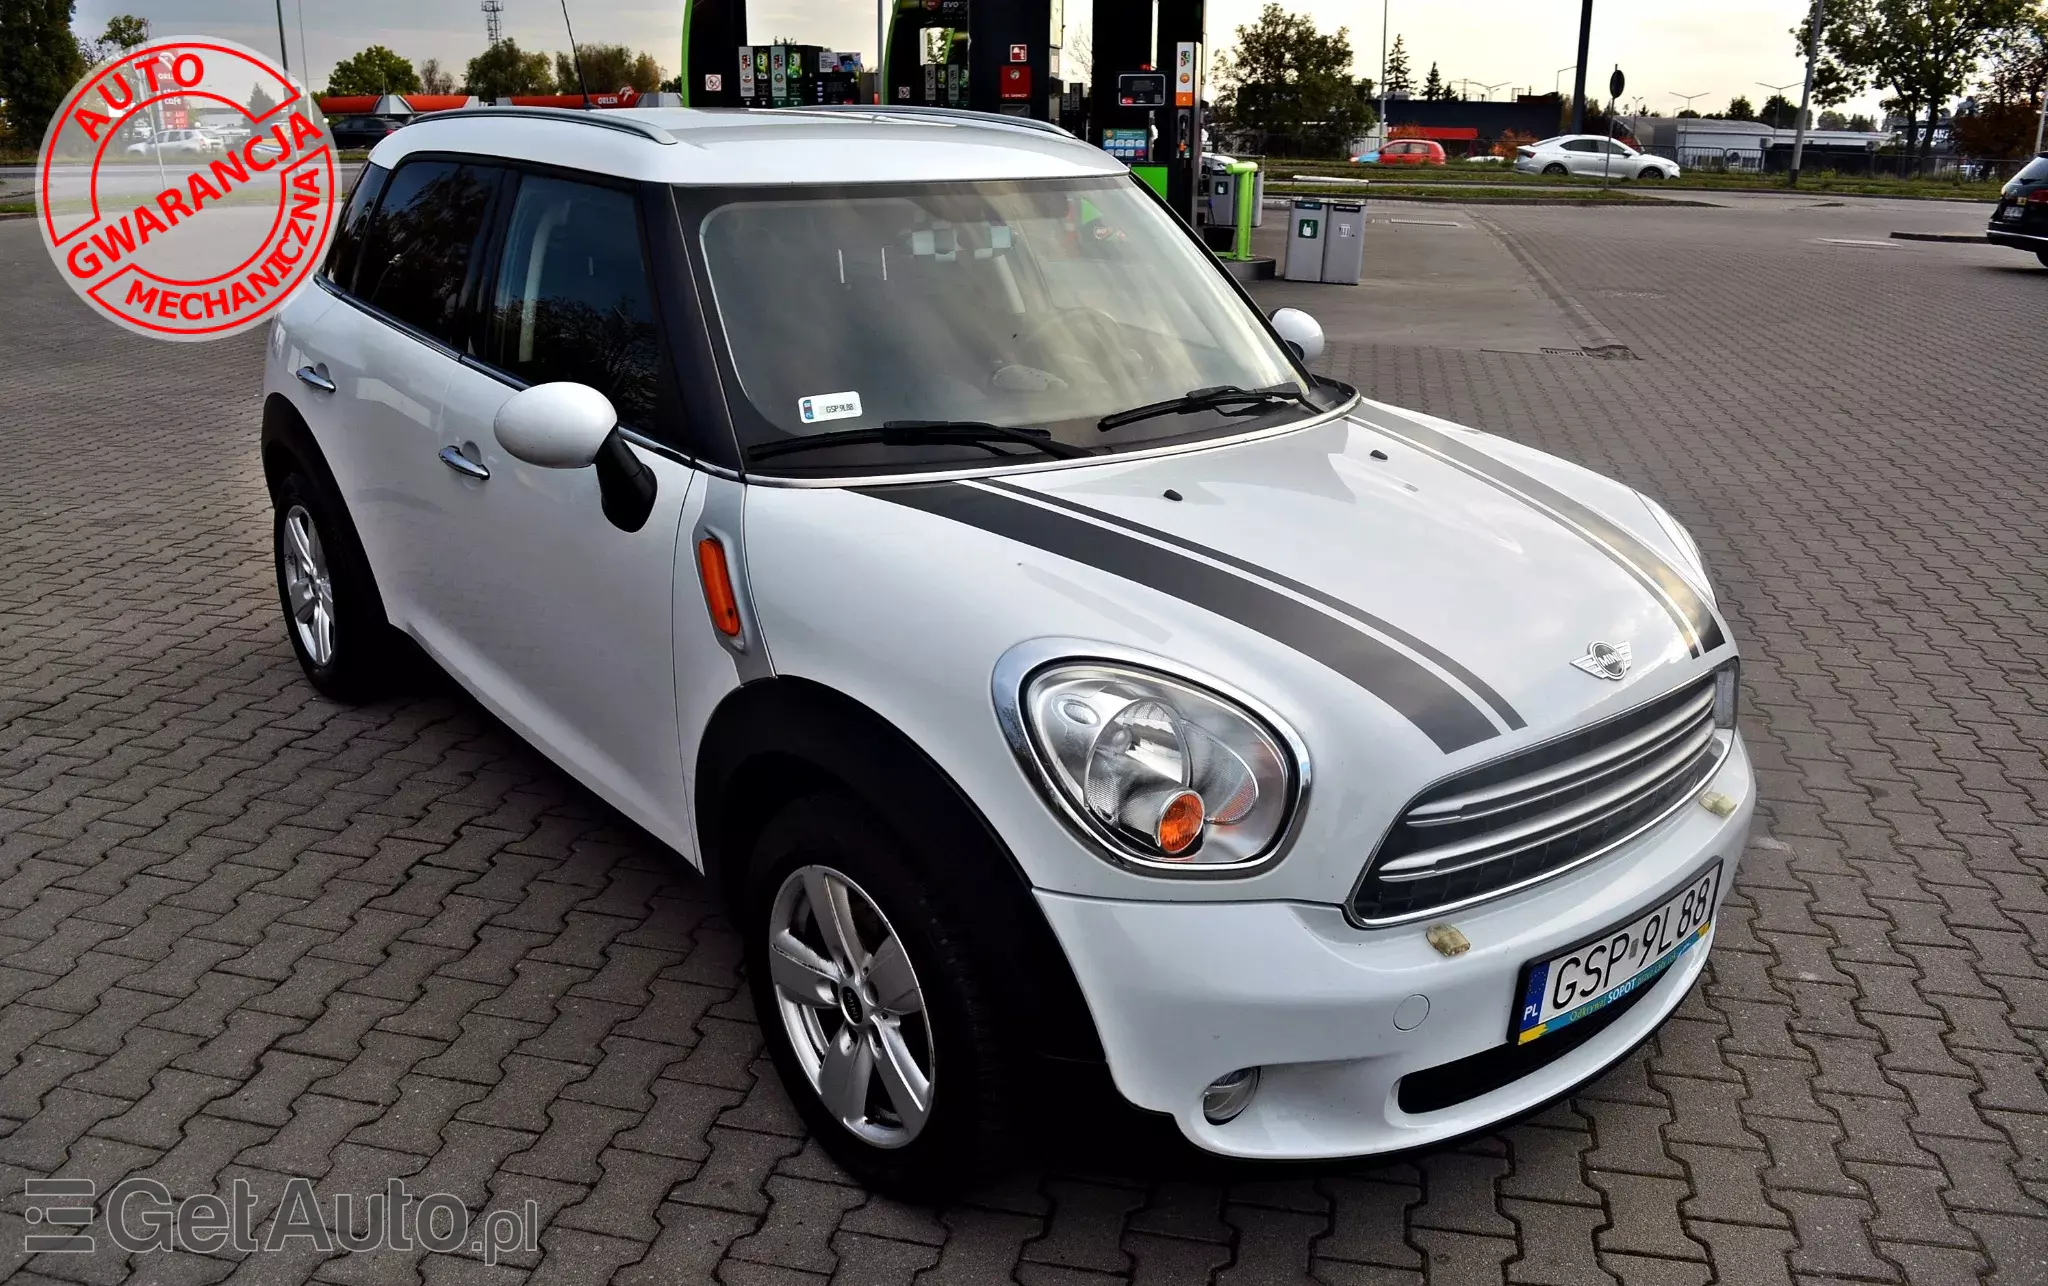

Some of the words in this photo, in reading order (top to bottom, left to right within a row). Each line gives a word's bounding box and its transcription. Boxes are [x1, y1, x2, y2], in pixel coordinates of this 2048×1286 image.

[598, 96, 618, 104] ORLEN
[825, 405, 839, 414] GSP
[1552, 932, 1630, 1010] GSP
[1637, 877, 1711, 969] 9L88
[1607, 977, 1637, 1004] SOPOT
[846, 992, 859, 1019] MINI
[1523, 1003, 1539, 1021] PL
